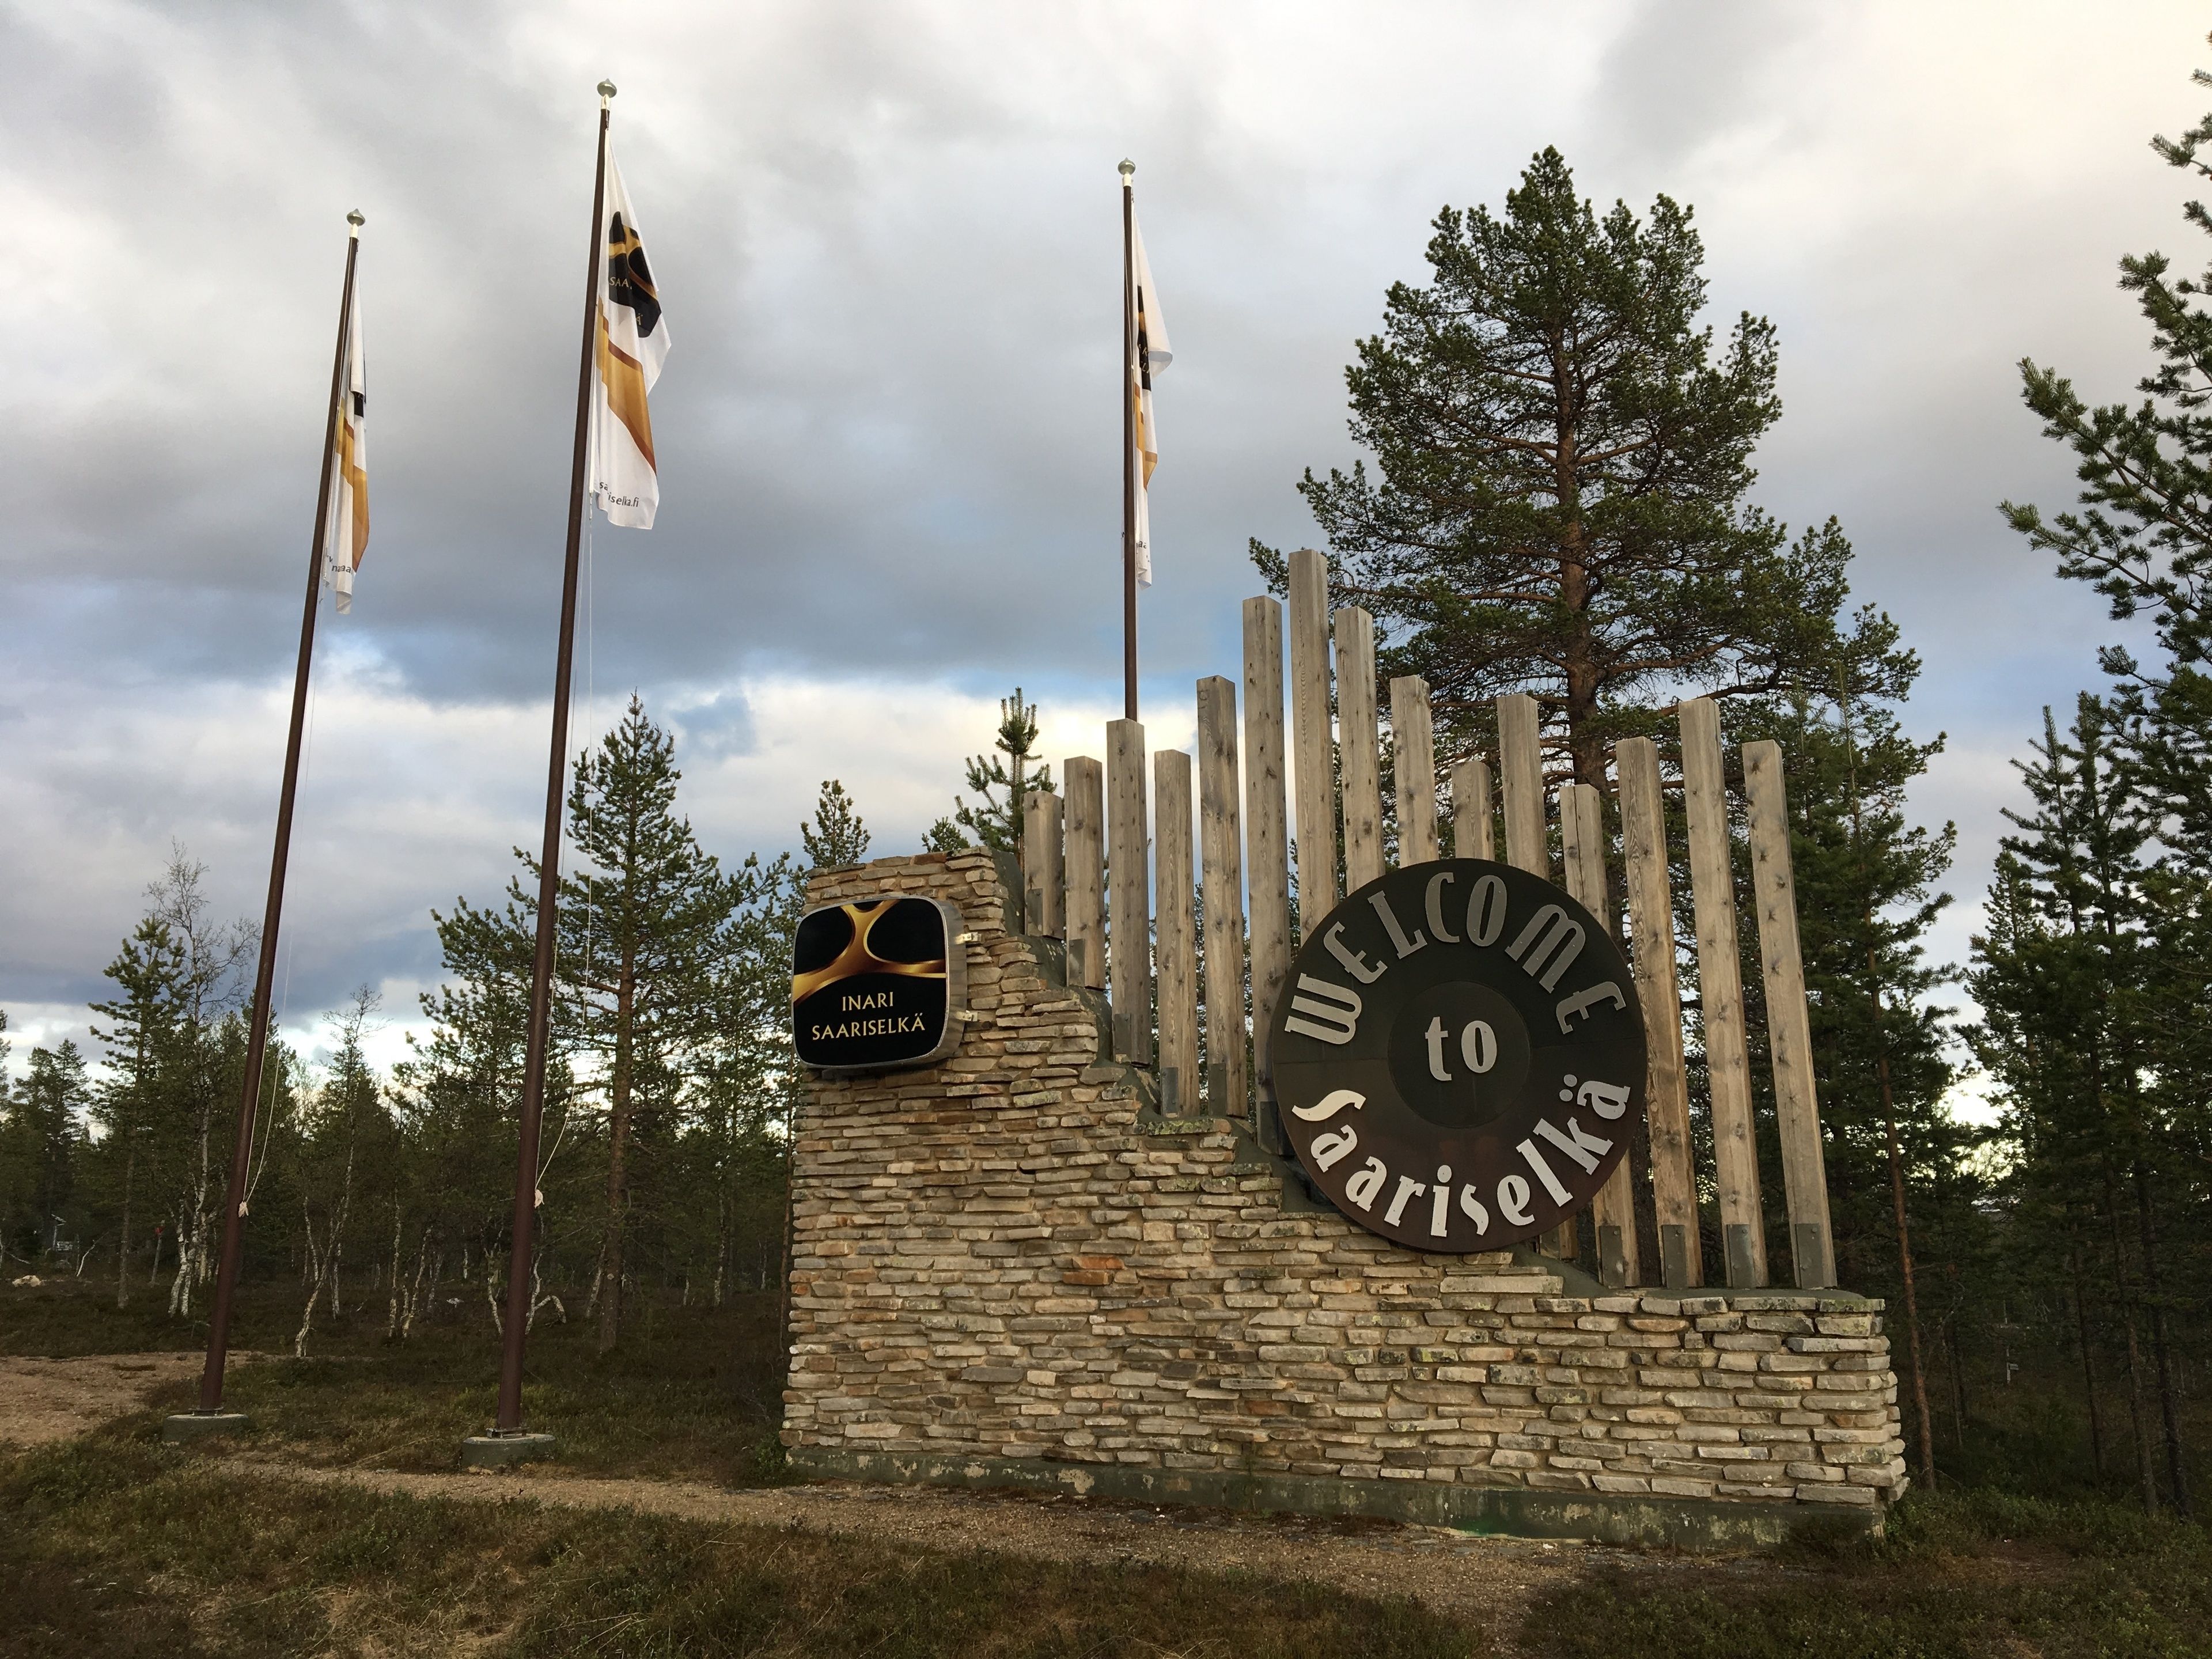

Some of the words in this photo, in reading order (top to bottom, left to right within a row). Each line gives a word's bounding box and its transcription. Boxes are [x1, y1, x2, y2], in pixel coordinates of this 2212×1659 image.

[1284, 872, 1626, 1045] WELCOME
[812, 1012, 925, 1040] SAARISELKÄ
[842, 991, 893, 1011] INARI
[1425, 1016, 1498, 1081] to
[1291, 1074, 1631, 1237] Saariselkä
